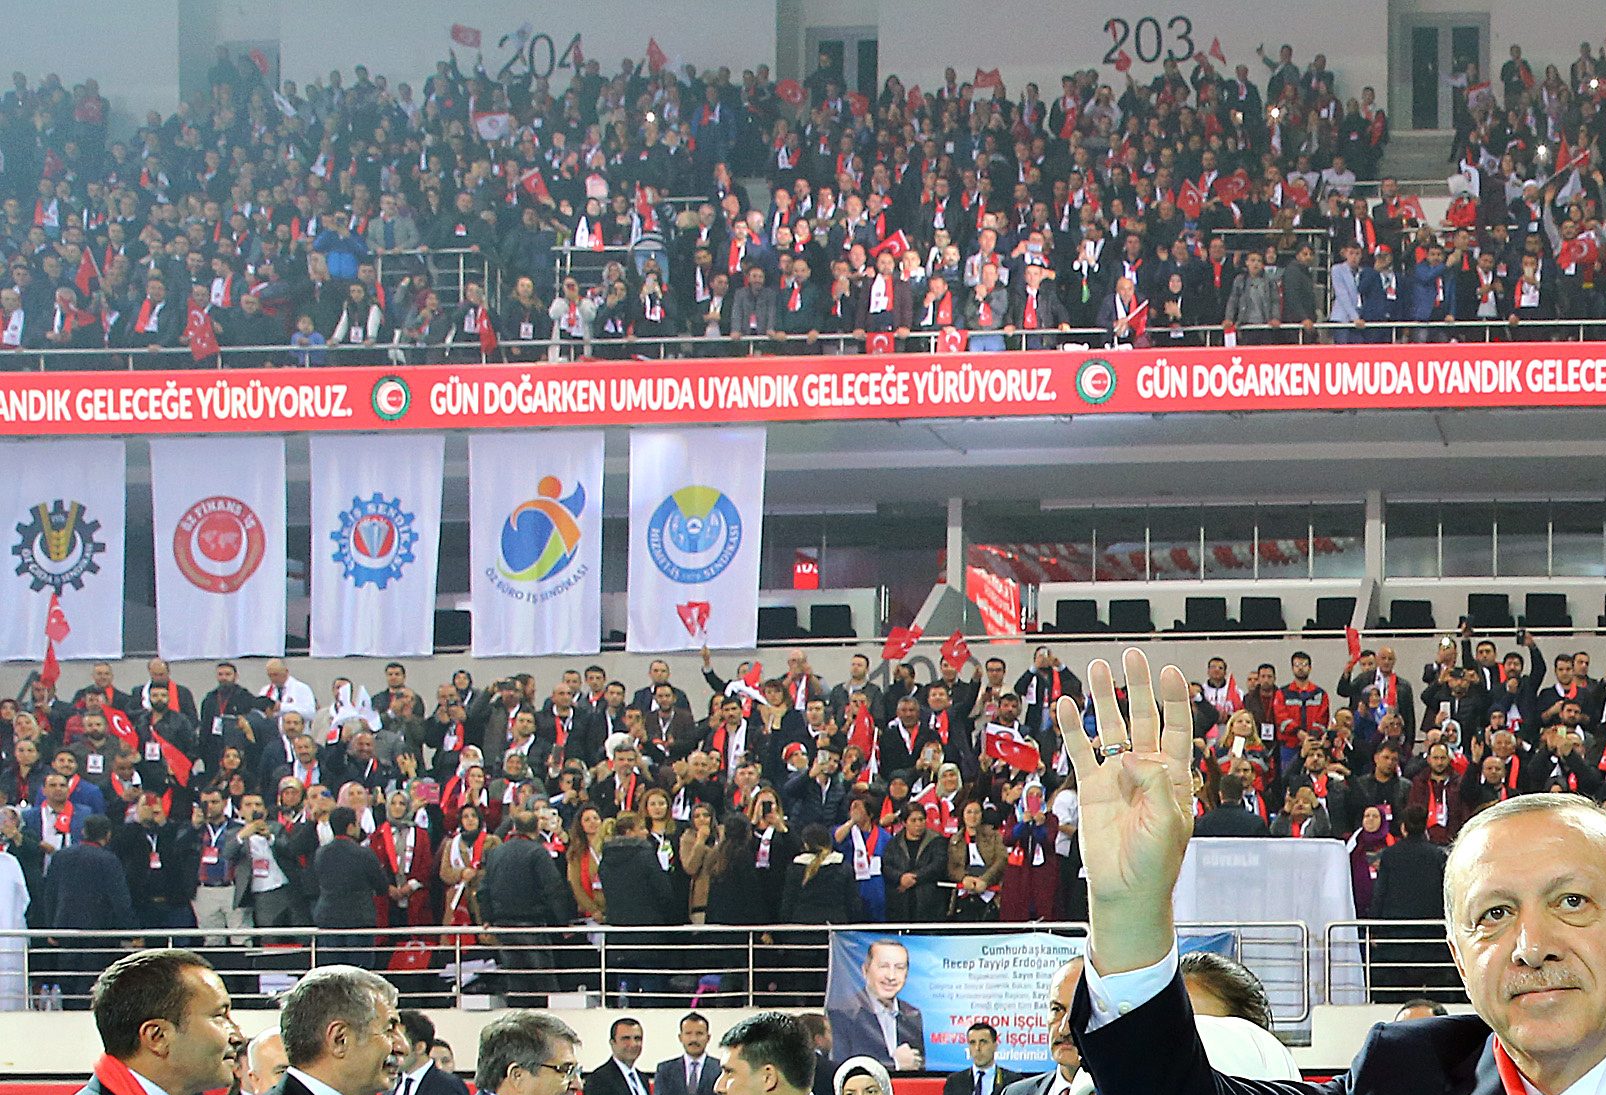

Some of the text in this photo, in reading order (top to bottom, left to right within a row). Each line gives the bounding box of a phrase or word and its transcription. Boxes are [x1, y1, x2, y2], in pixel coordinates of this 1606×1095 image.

[498, 33, 583, 80] 204
[1103, 16, 1194, 64] 203
[429, 363, 1057, 415] GÜN DOĞARKEN UMUDA UYANDIK GELECEĞE YÜRÜYORUZ.
[1136, 359, 1188, 398] GÜN
[1192, 357, 1321, 397] DOĞARKEN
[1325, 361, 1414, 395] UMUDA
[1417, 360, 1523, 393] UYANDIK
[0, 380, 353, 421] ANDIK GELECEĞE YÜRÜYORUZ.
[943, 958, 975, 971] Recep
[978, 957, 1010, 970] Tayyip
[1014, 1012, 1046, 1030] İŞÇİL
